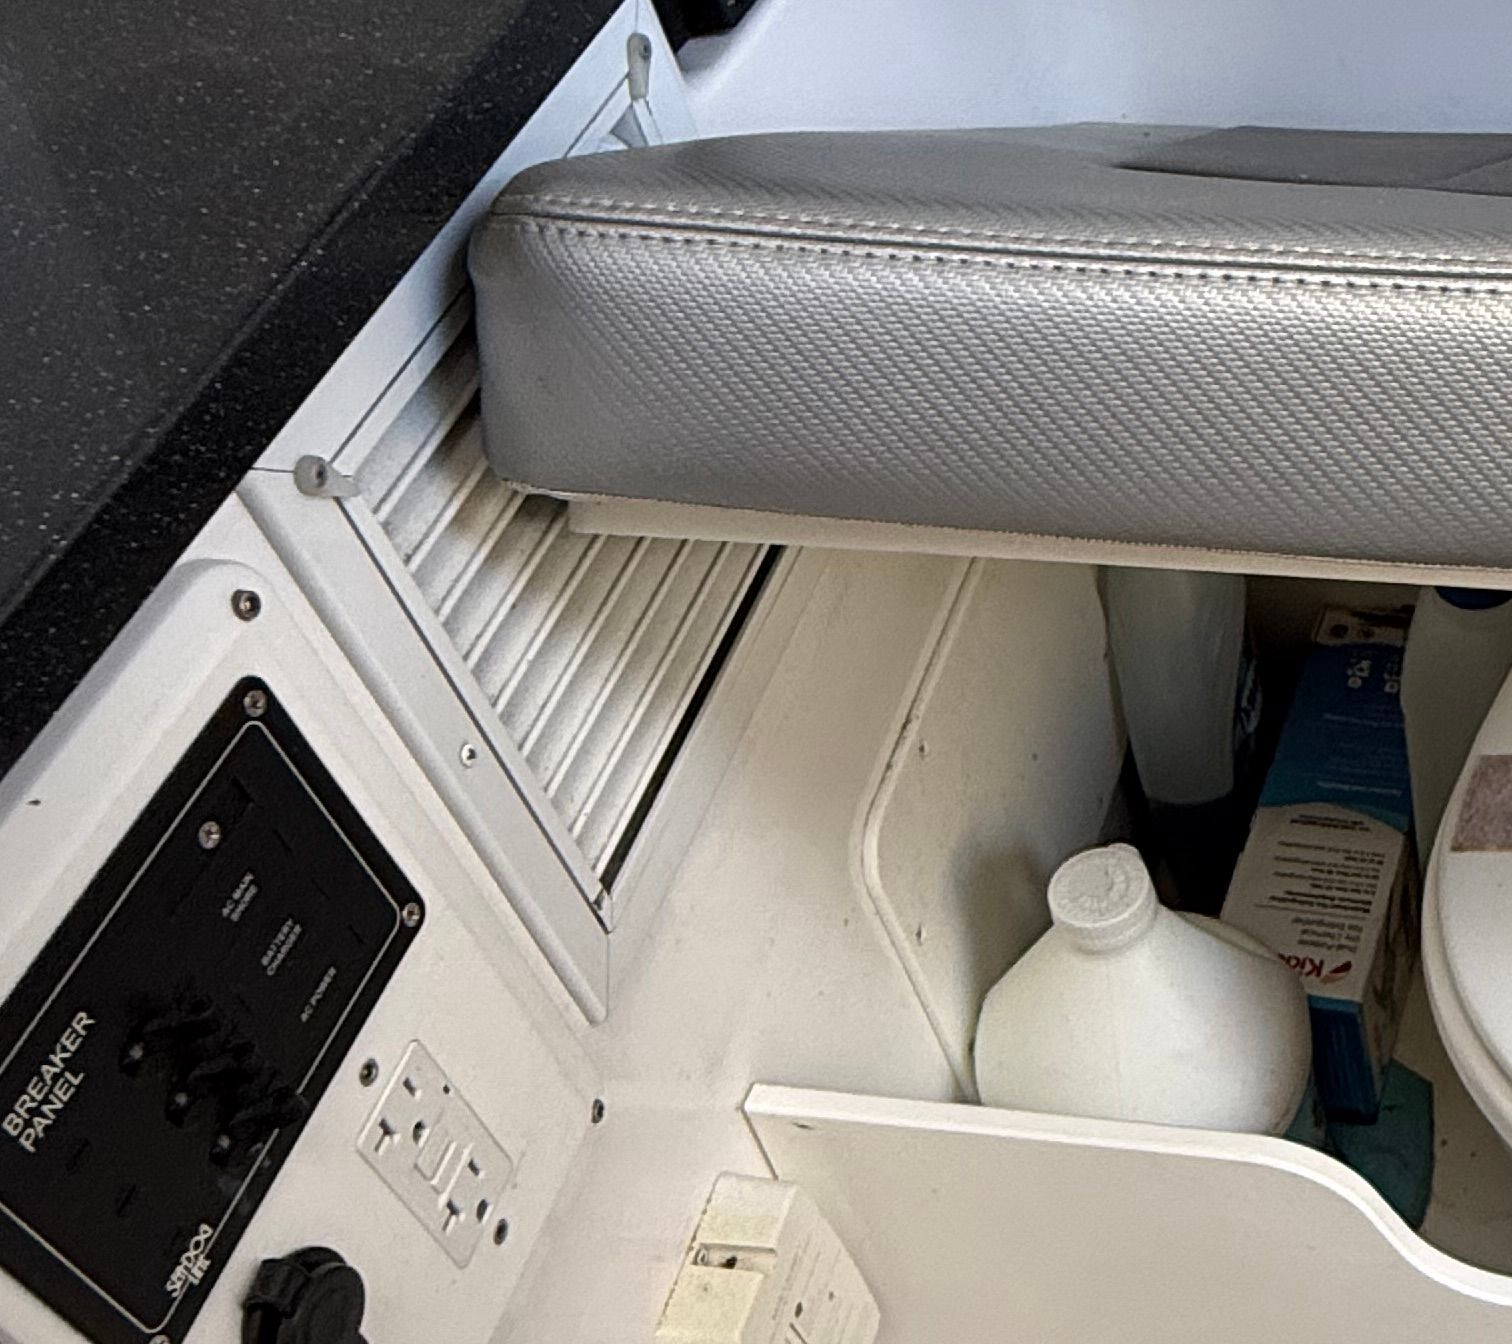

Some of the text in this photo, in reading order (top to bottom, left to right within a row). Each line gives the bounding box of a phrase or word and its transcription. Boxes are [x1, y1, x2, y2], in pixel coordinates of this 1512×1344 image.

[261, 918, 293, 966] BATTERY
[266, 923, 302, 976] CHARGER
[309, 966, 336, 1006] POWER
[2, 1011, 96, 1137] BREAKER
[18, 1070, 86, 1153] PANEL
